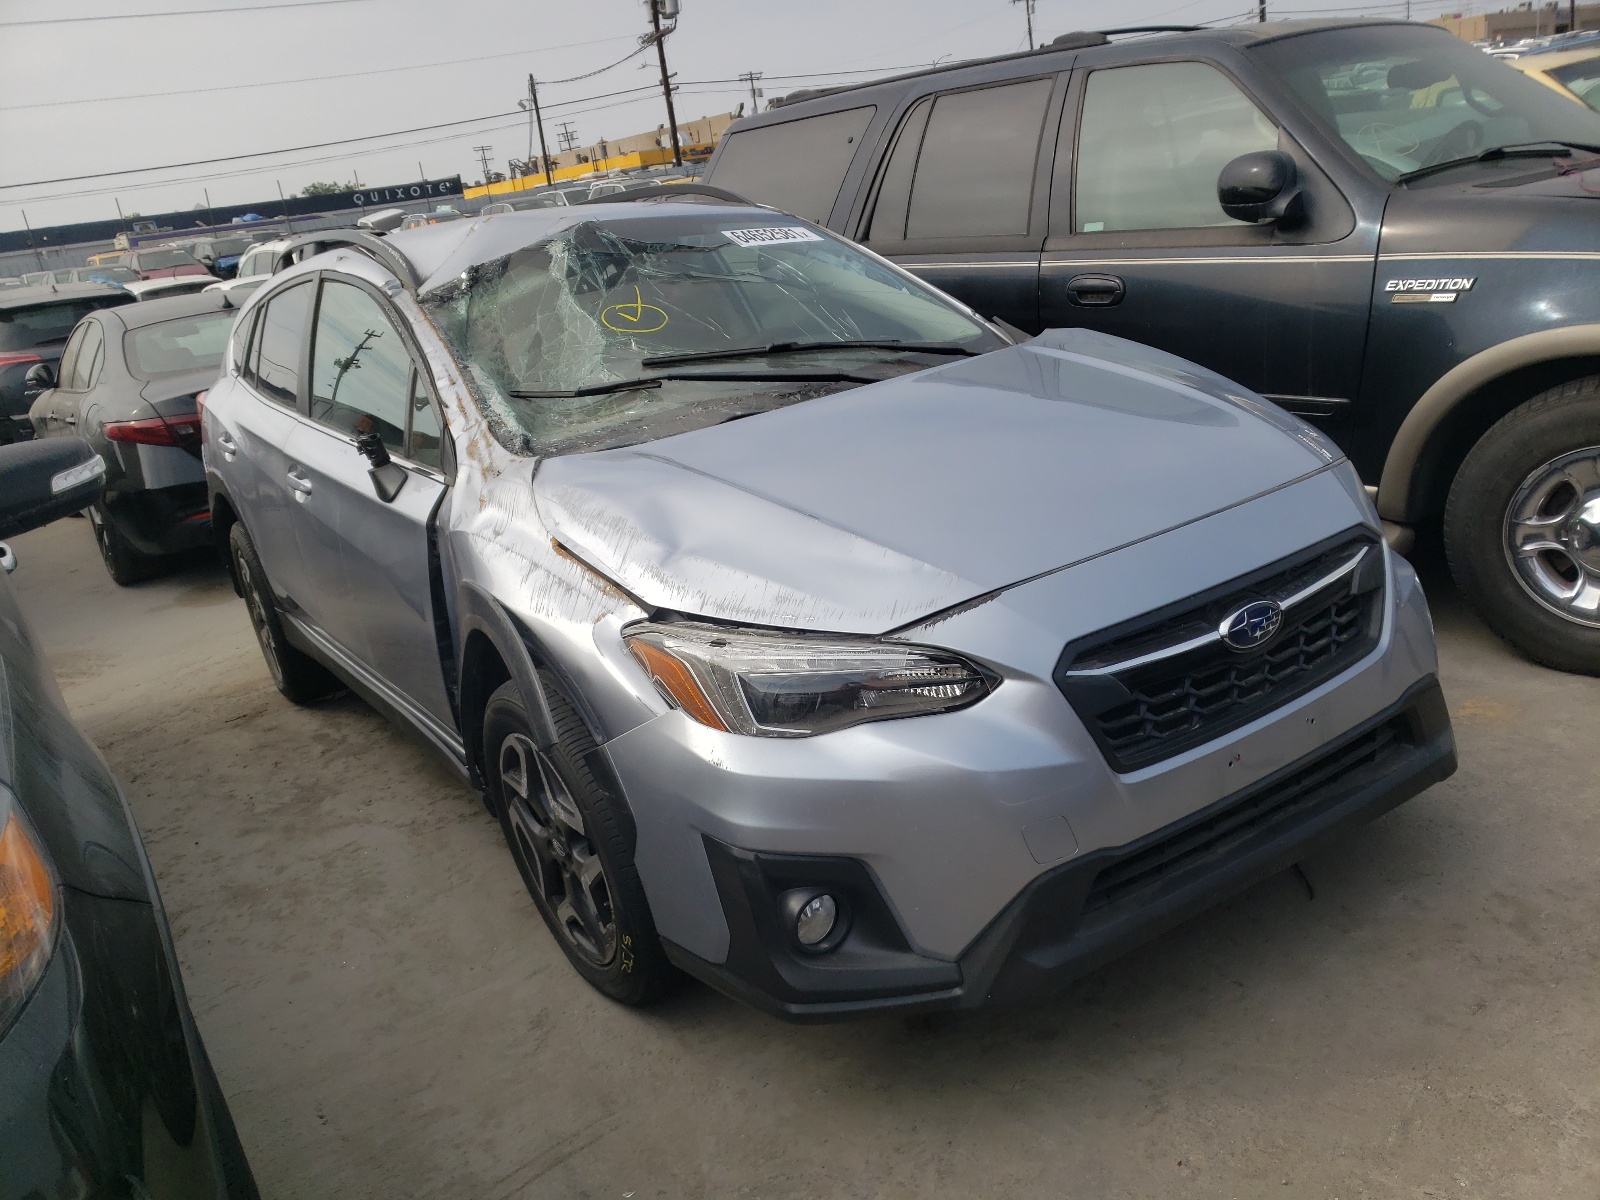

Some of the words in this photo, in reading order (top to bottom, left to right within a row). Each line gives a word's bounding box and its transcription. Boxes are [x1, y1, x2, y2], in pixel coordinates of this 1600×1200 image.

[353, 182, 448, 205] QUIXOTE
[730, 228, 804, 243] 64652581
[1384, 278, 1475, 292] EXPEDITION
